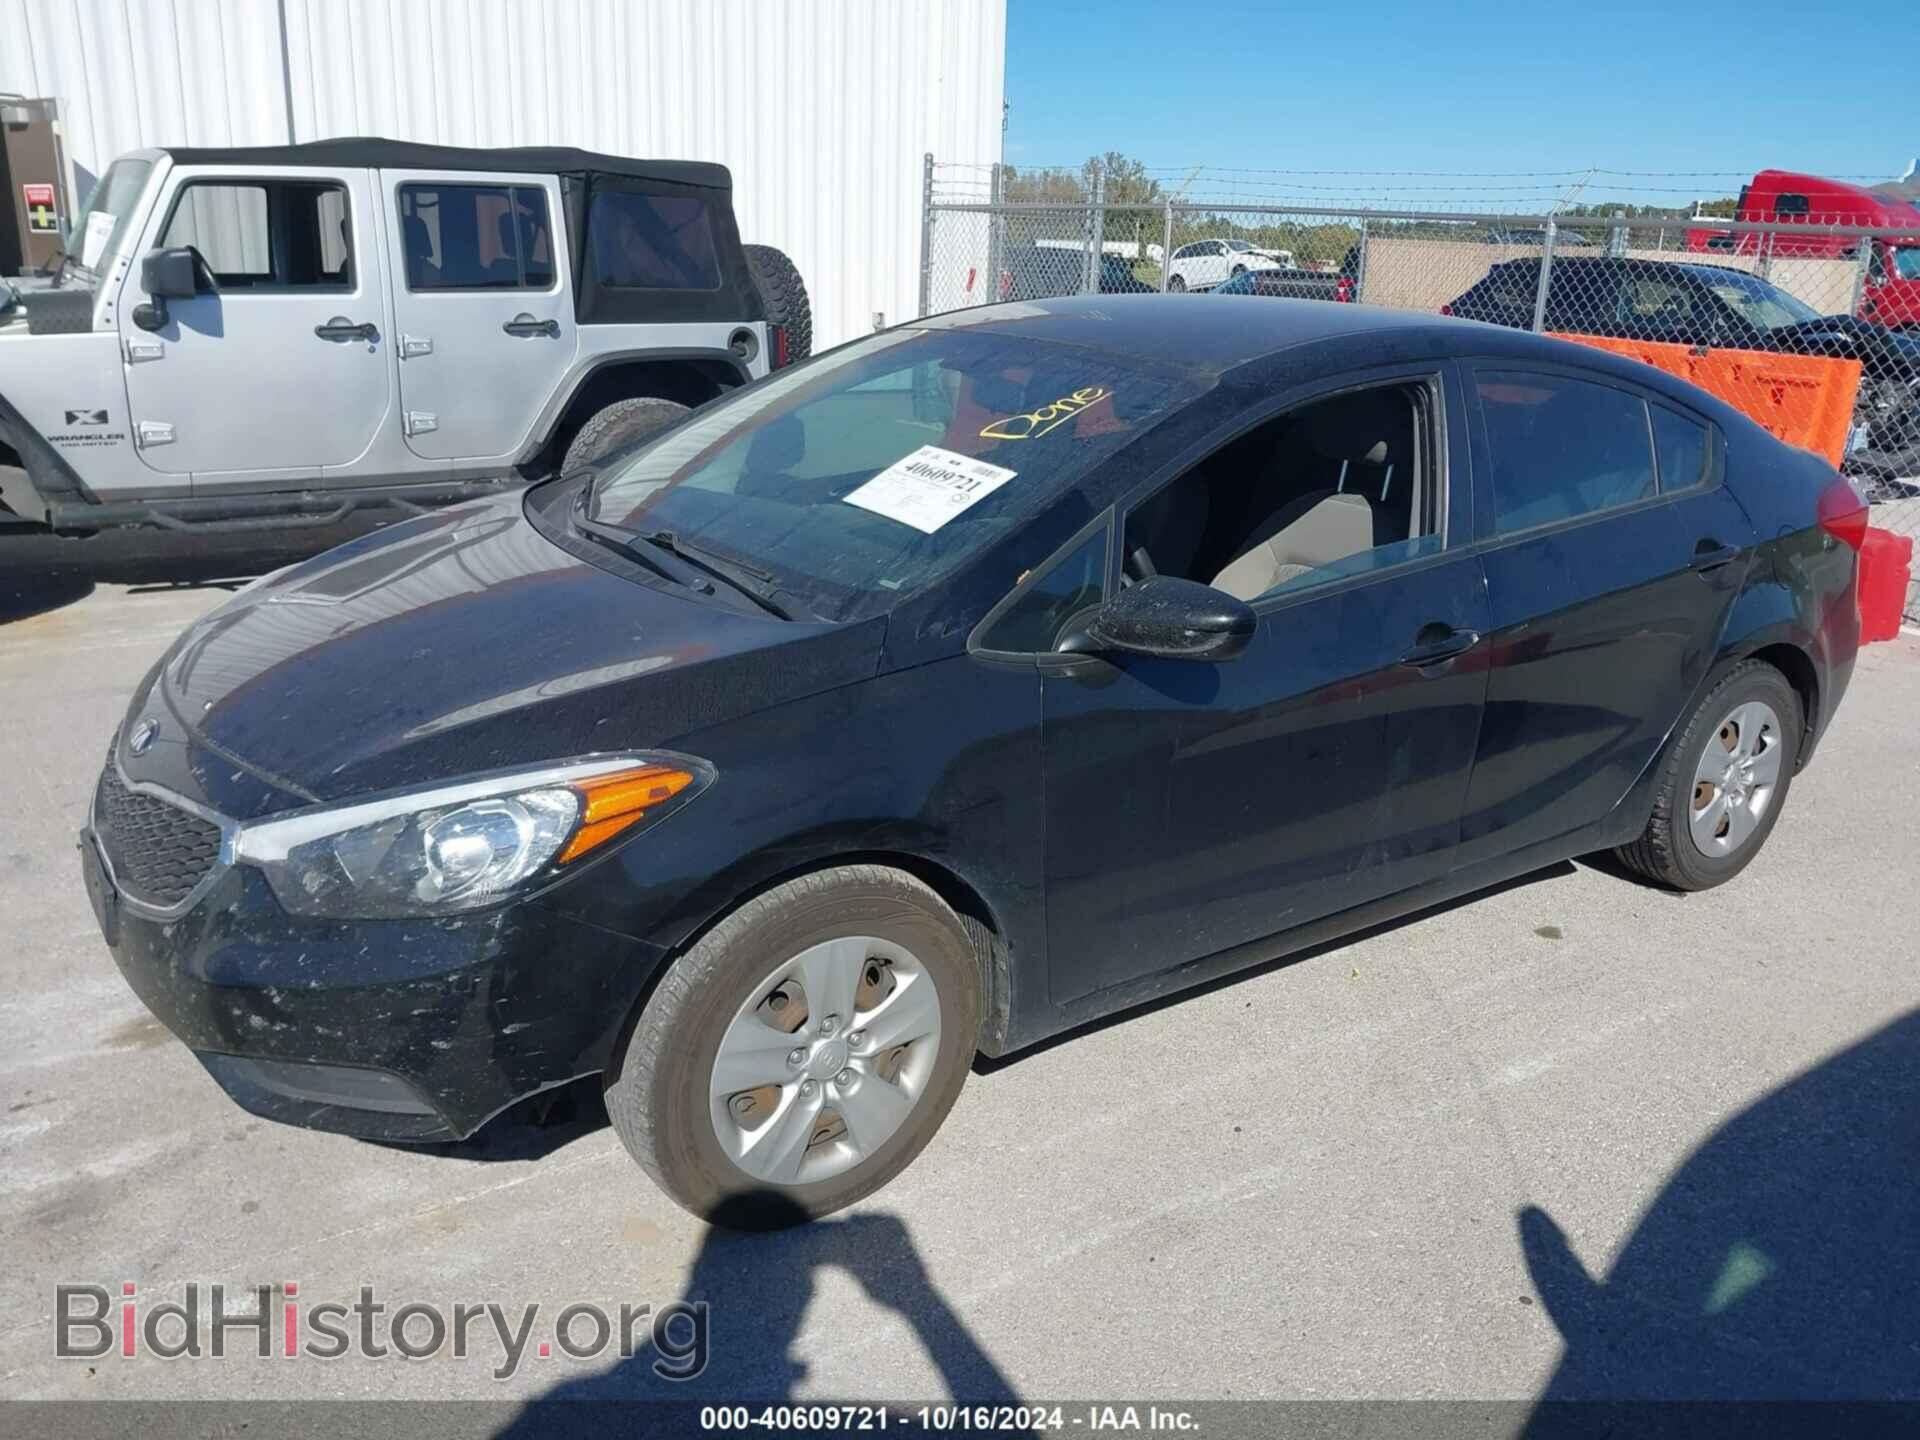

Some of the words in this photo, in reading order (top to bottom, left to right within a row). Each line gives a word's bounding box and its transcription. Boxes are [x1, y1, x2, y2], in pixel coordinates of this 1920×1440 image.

[979, 387, 1104, 439] Done
[47, 434, 125, 442] WRANGLER
[904, 461, 982, 493] 40609721
